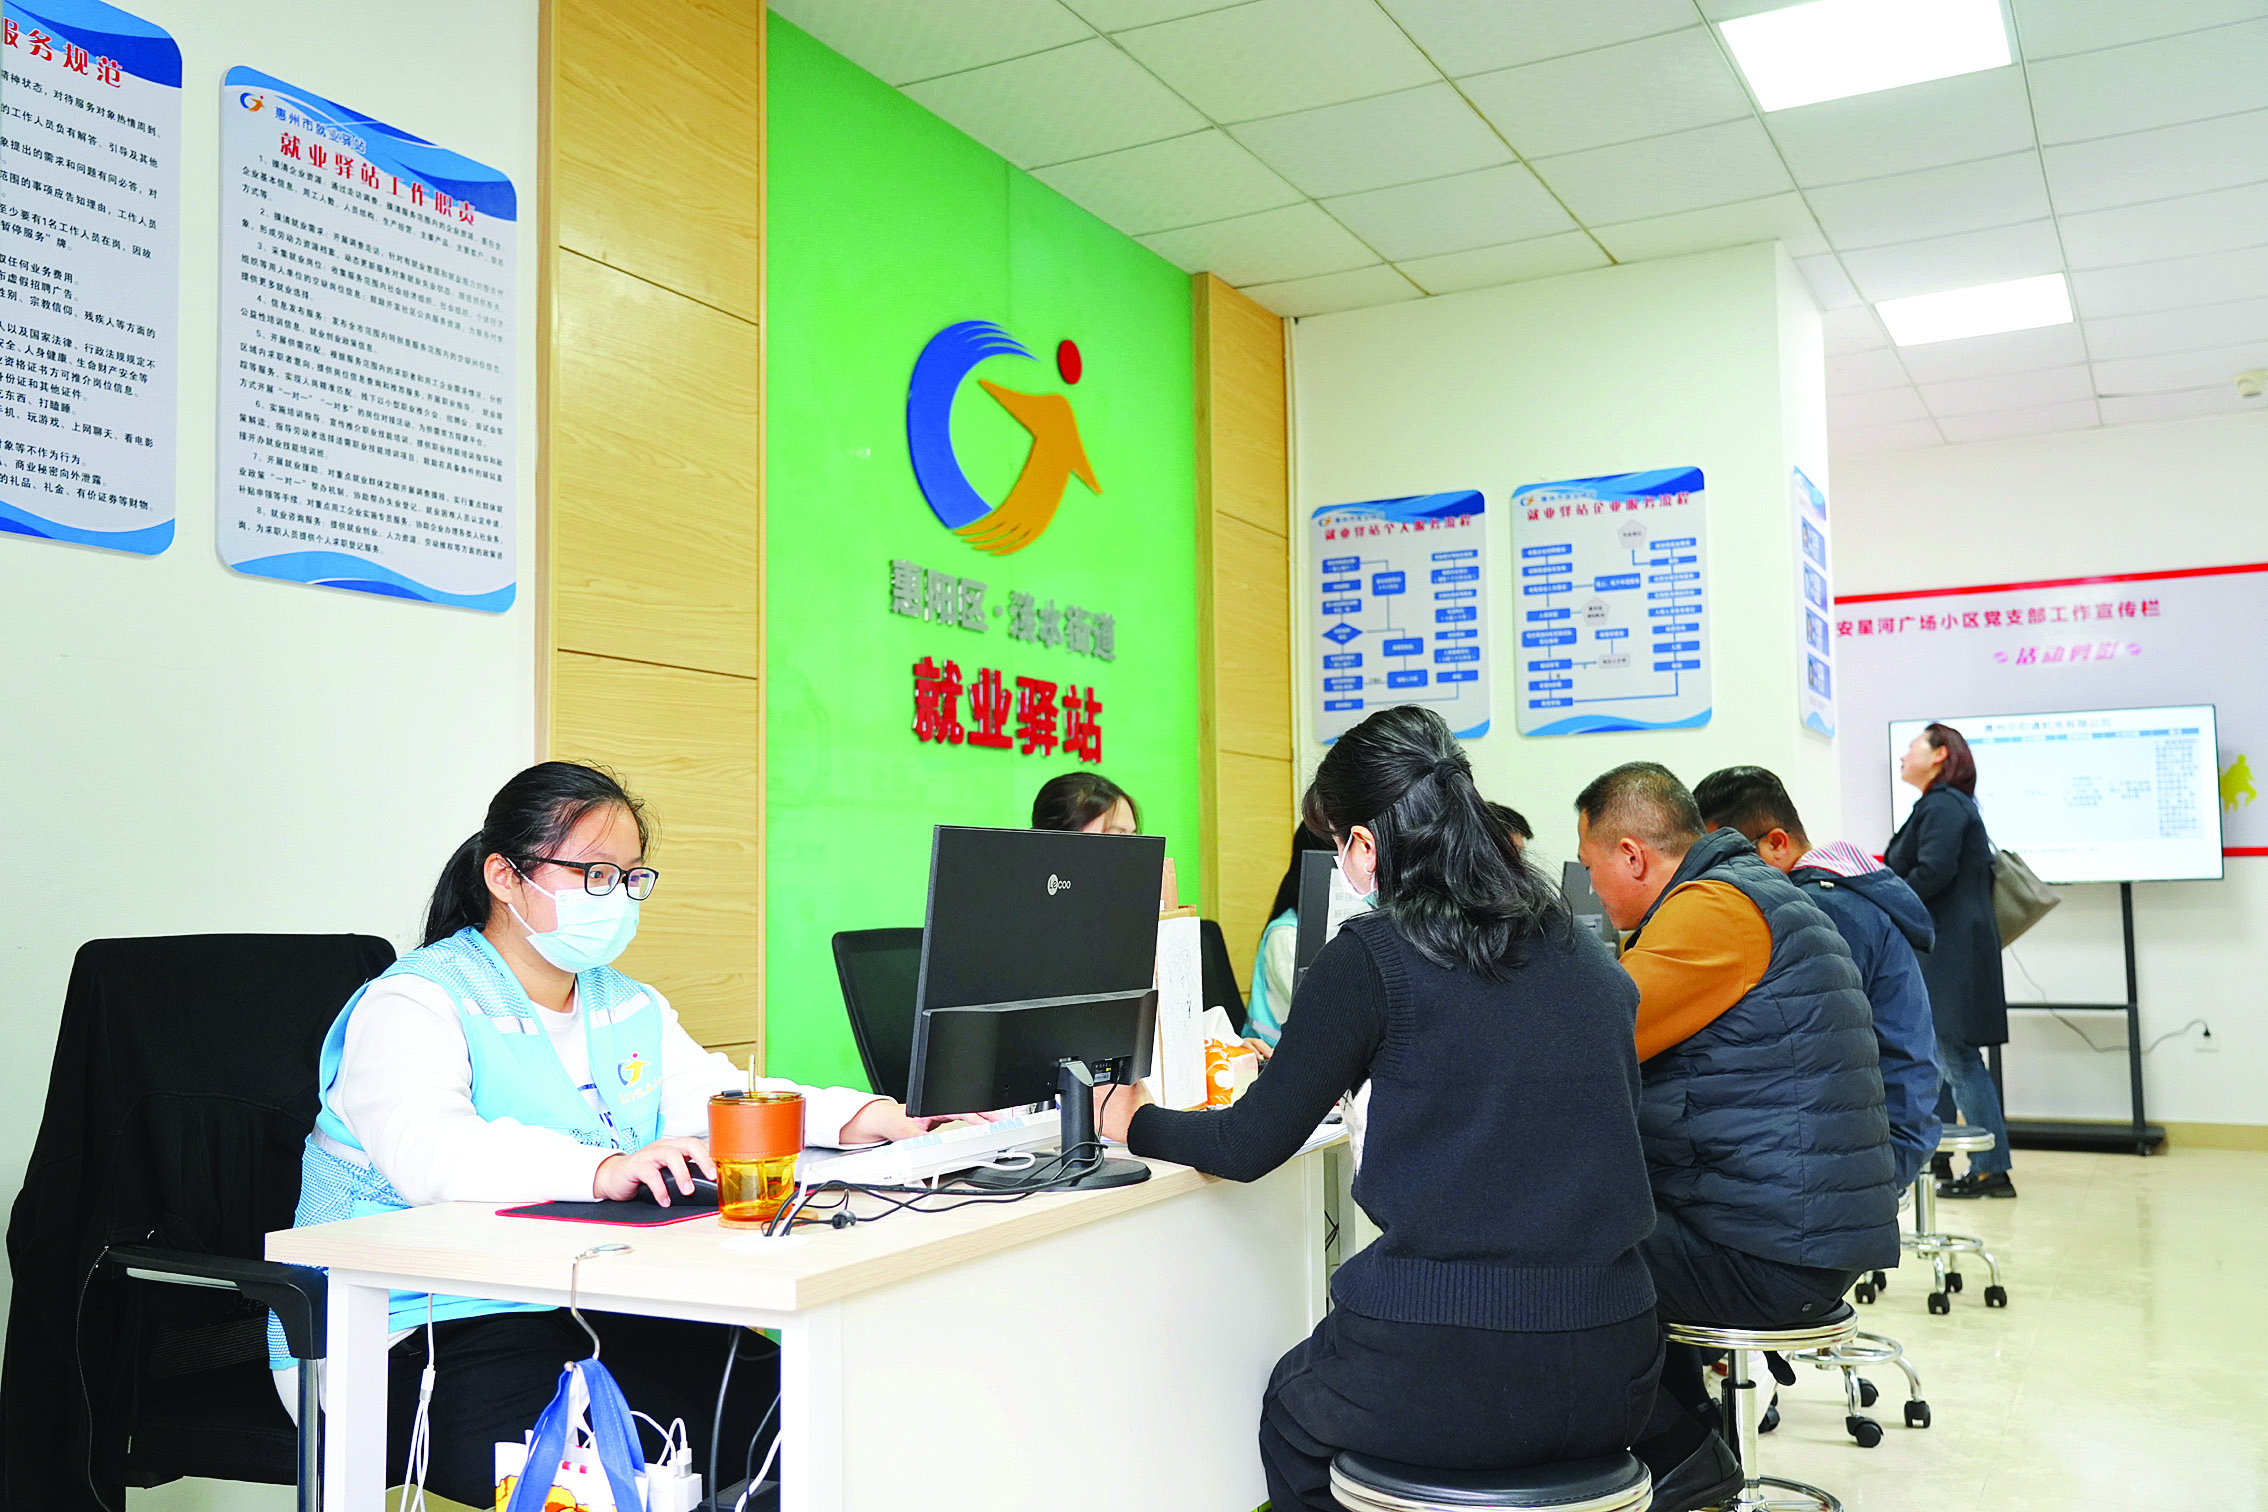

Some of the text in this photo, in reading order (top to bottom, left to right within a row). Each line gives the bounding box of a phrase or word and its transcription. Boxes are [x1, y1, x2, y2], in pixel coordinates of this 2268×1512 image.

[280, 132, 476, 226] 就业驿站工作职责
[1528, 492, 1690, 521] 就业驿站企业服务流程
[912, 656, 1103, 764] 就业驿站
